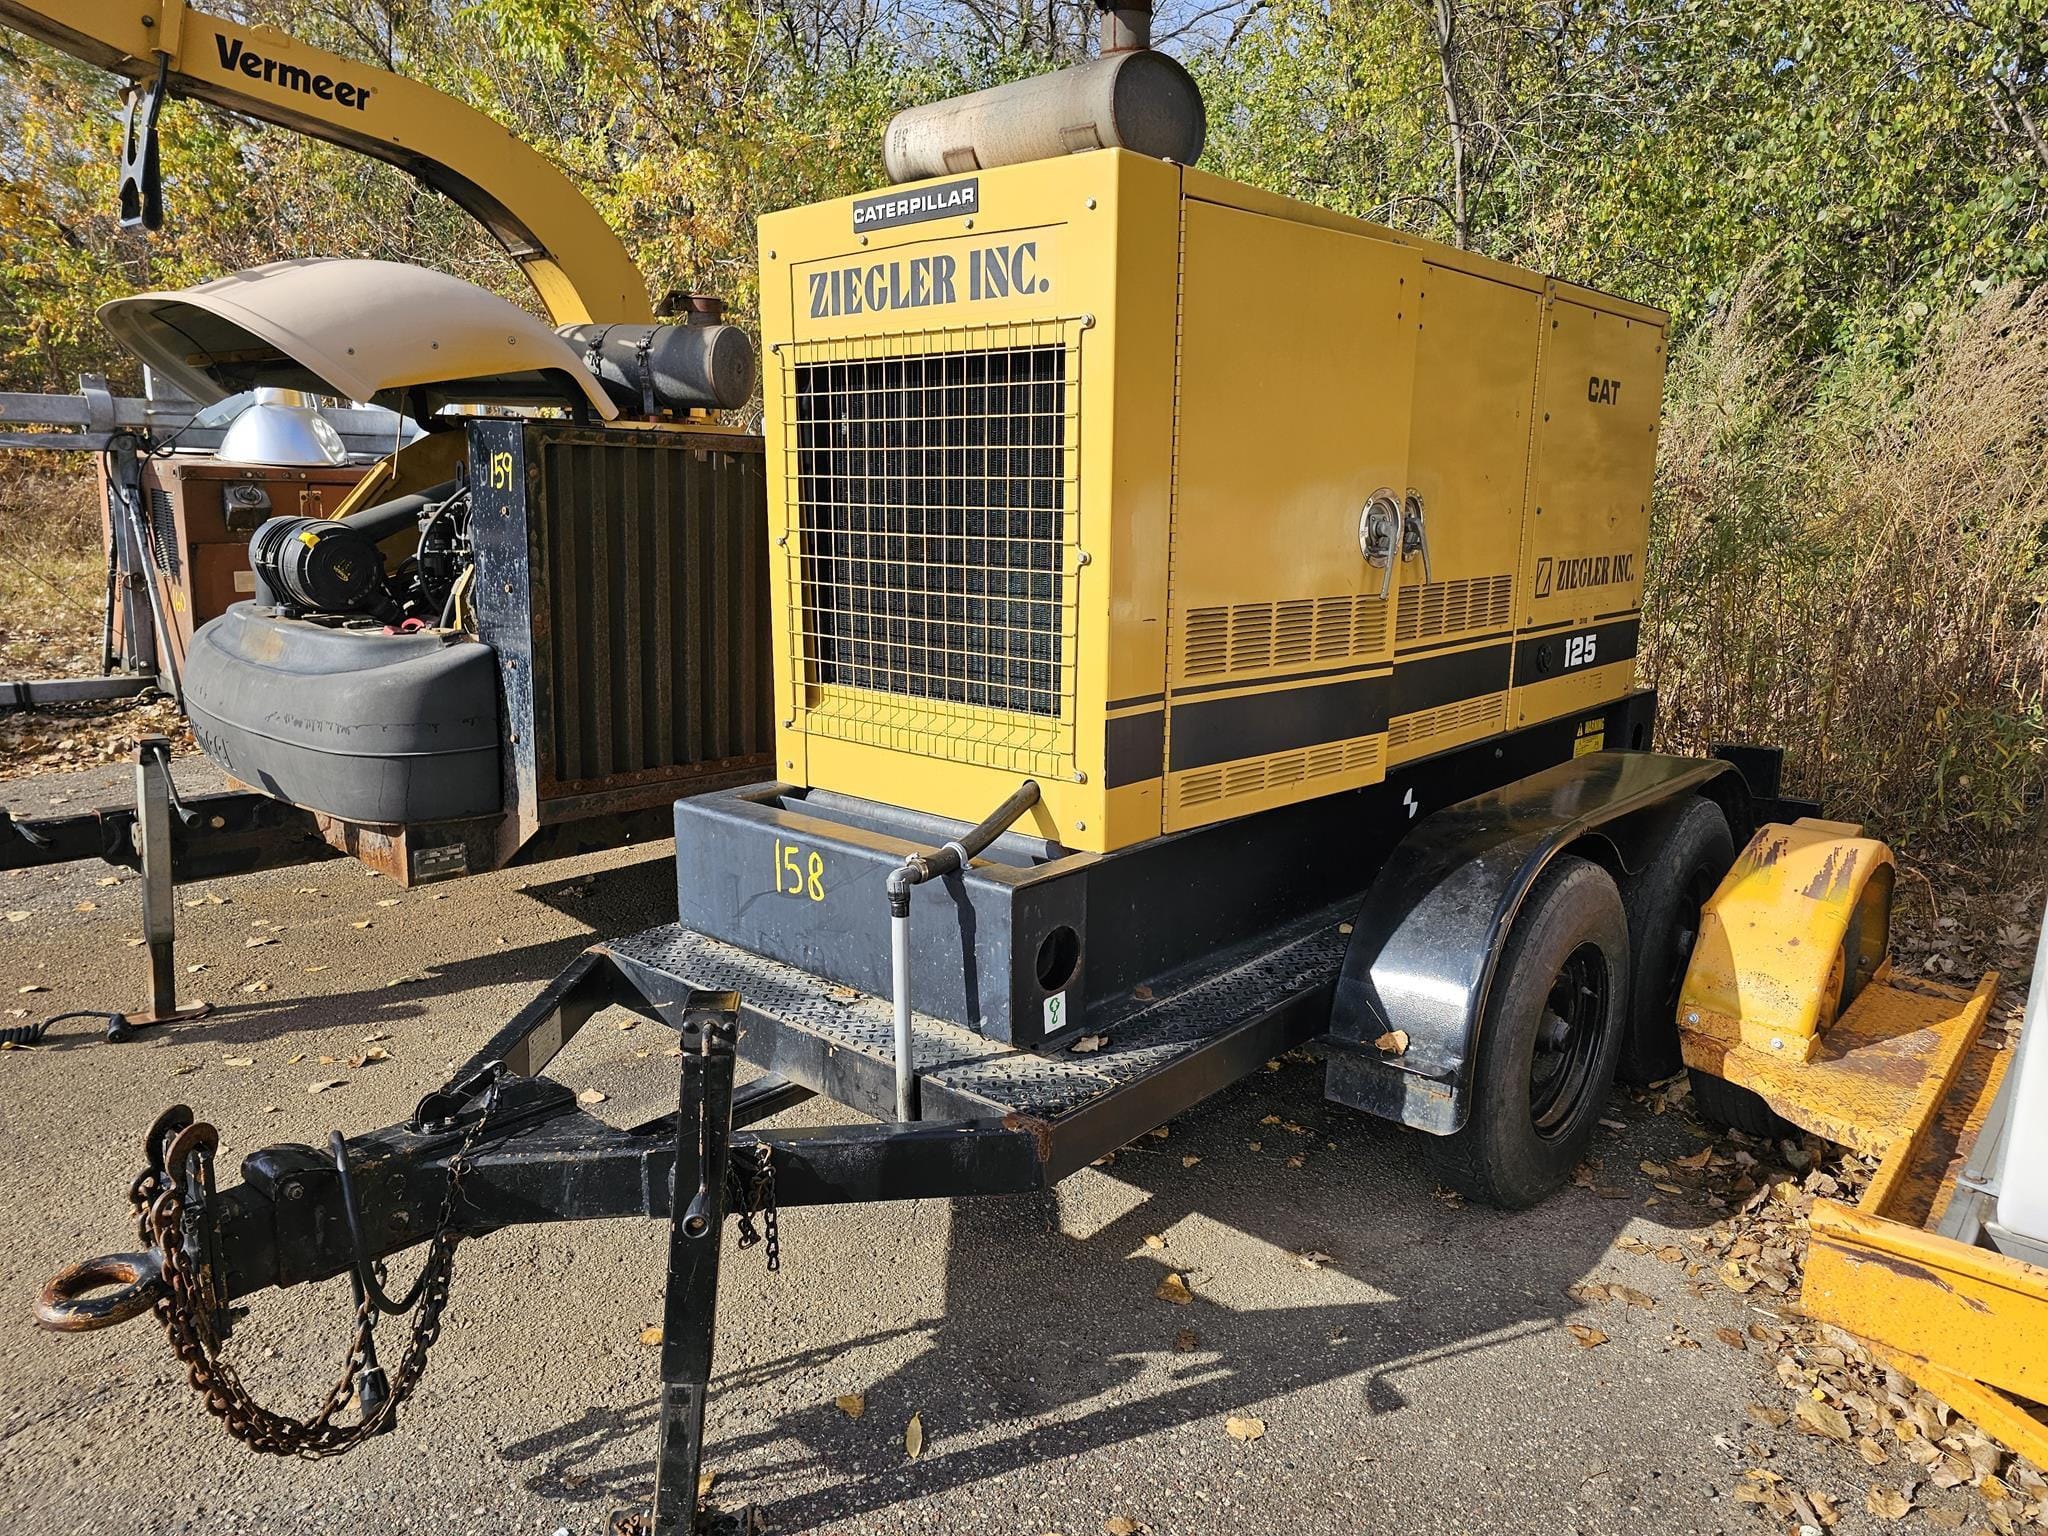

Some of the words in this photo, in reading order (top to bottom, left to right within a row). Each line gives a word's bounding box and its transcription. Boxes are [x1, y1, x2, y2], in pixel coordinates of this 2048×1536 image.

[215, 33, 371, 111] Vermeer
[854, 187, 975, 224] CATERPILLAR
[809, 254, 957, 319] ZIEGLER
[969, 241, 1050, 301] INC.
[1588, 376, 1621, 406] CAT
[490, 448, 513, 492] 159
[1556, 556, 1610, 592] ZIEGLER
[1612, 553, 1635, 584] INC.
[1564, 633, 1597, 668] 125
[775, 838, 825, 902] 158
